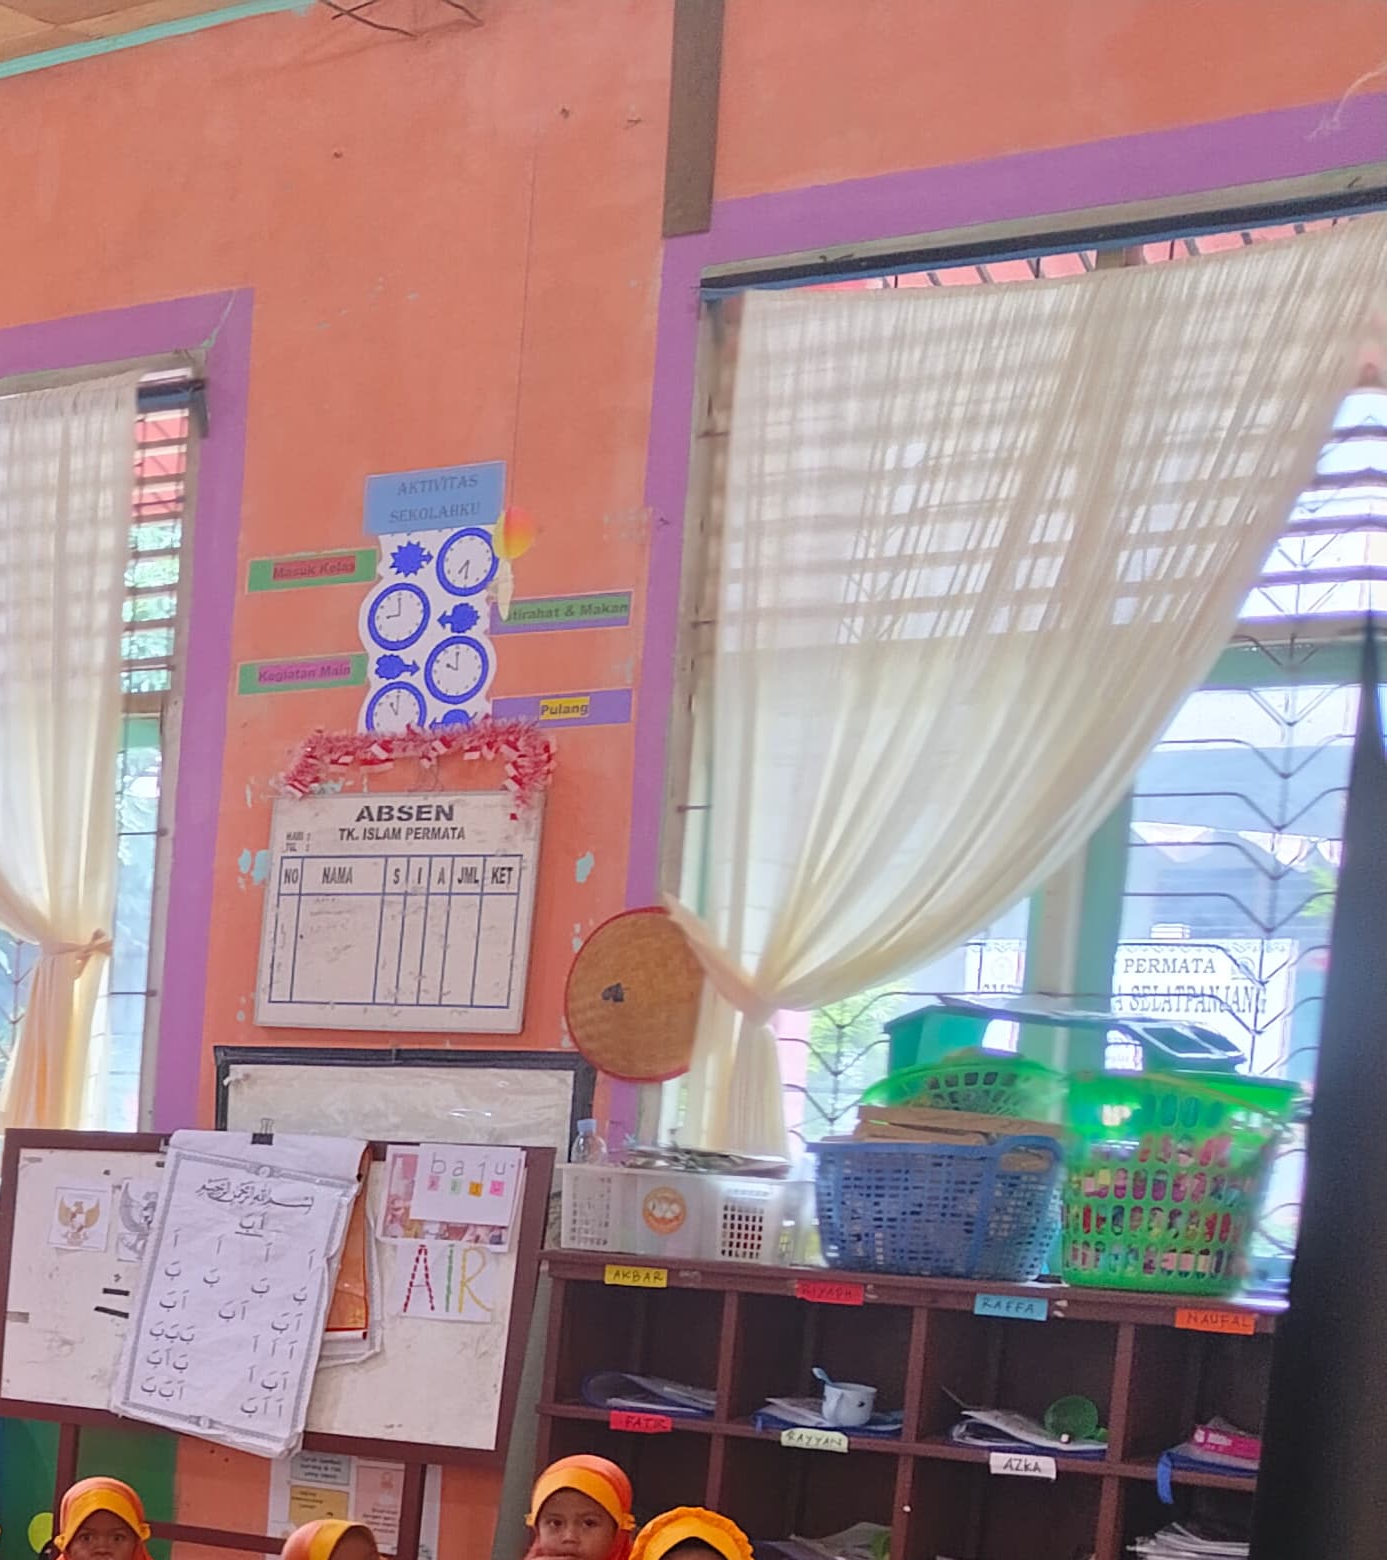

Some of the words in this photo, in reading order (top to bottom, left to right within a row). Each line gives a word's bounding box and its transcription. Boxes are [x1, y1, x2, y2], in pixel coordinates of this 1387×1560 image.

[397, 474, 478, 496] AKTIVITAS
[389, 502, 481, 523] SEKOLAHKU
[273, 562, 314, 580] Masuk
[509, 607, 559, 621] tirahat
[565, 605, 574, 617] &
[580, 603, 627, 616] Makan
[259, 667, 317, 685] Kegiatan
[320, 663, 351, 678] Main
[540, 702, 589, 718] Pulang
[355, 804, 454, 823] ABSEN
[338, 827, 360, 841] TK.
[363, 828, 402, 841] ISLAM
[405, 827, 466, 841] PERMATA
[284, 868, 299, 884] NO
[322, 867, 353, 884] NAMA
[393, 868, 400, 885] S
[437, 868, 446, 885] A
[457, 867, 479, 885] JML
[491, 866, 513, 885] KET
[1124, 958, 1216, 974] PERMATA
[1130, 985, 1268, 1014] SELATPANJANG
[403, 1243, 494, 1313] AIR
[612, 1269, 664, 1283] AKBAR
[982, 1298, 1035, 1314] RAFFA
[1187, 1313, 1251, 1328] NAUFAL
